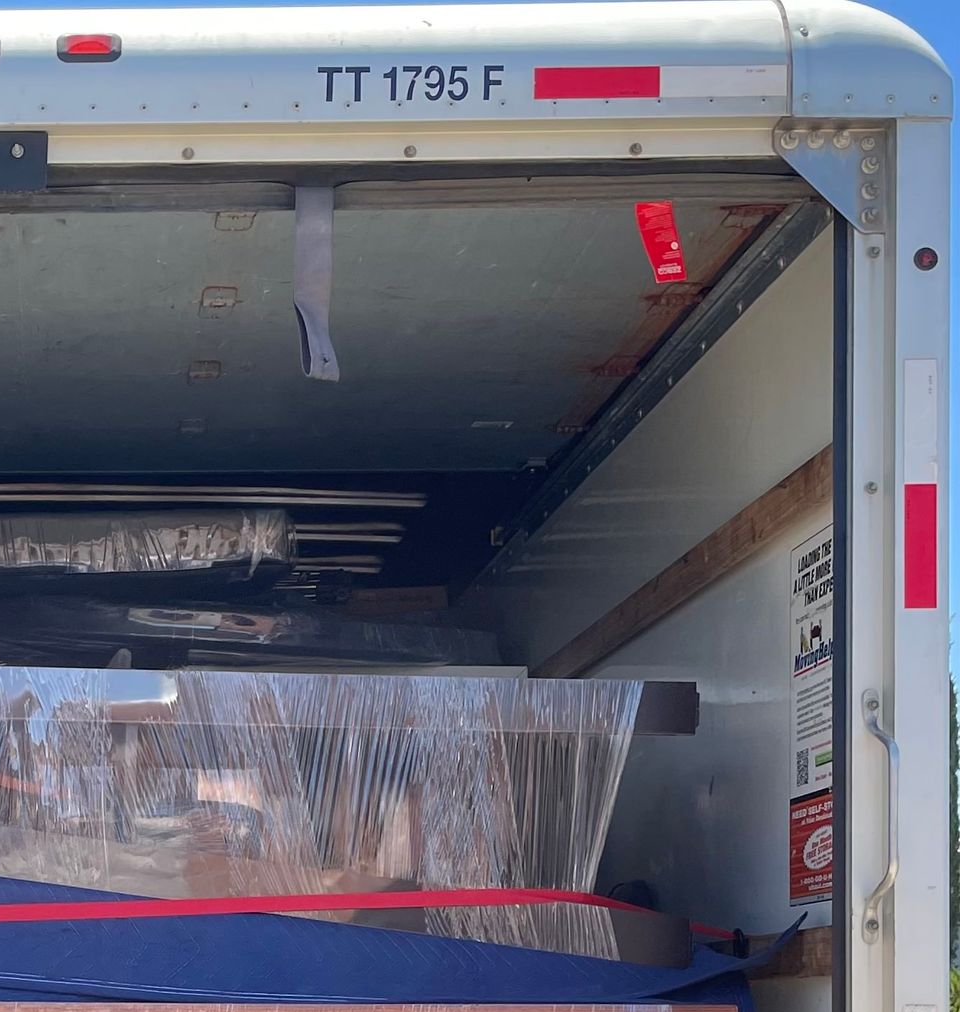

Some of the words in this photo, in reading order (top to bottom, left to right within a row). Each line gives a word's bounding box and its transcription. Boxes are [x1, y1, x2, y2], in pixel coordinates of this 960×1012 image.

[317, 66, 371, 102] TT
[383, 65, 469, 102] 1795
[483, 65, 505, 101] F
[798, 546, 820, 573] LOADING
[821, 538, 832, 557] THE
[798, 568, 814, 592] LITTLE
[815, 558, 832, 582] MORE
[804, 588, 818, 607] THAN
